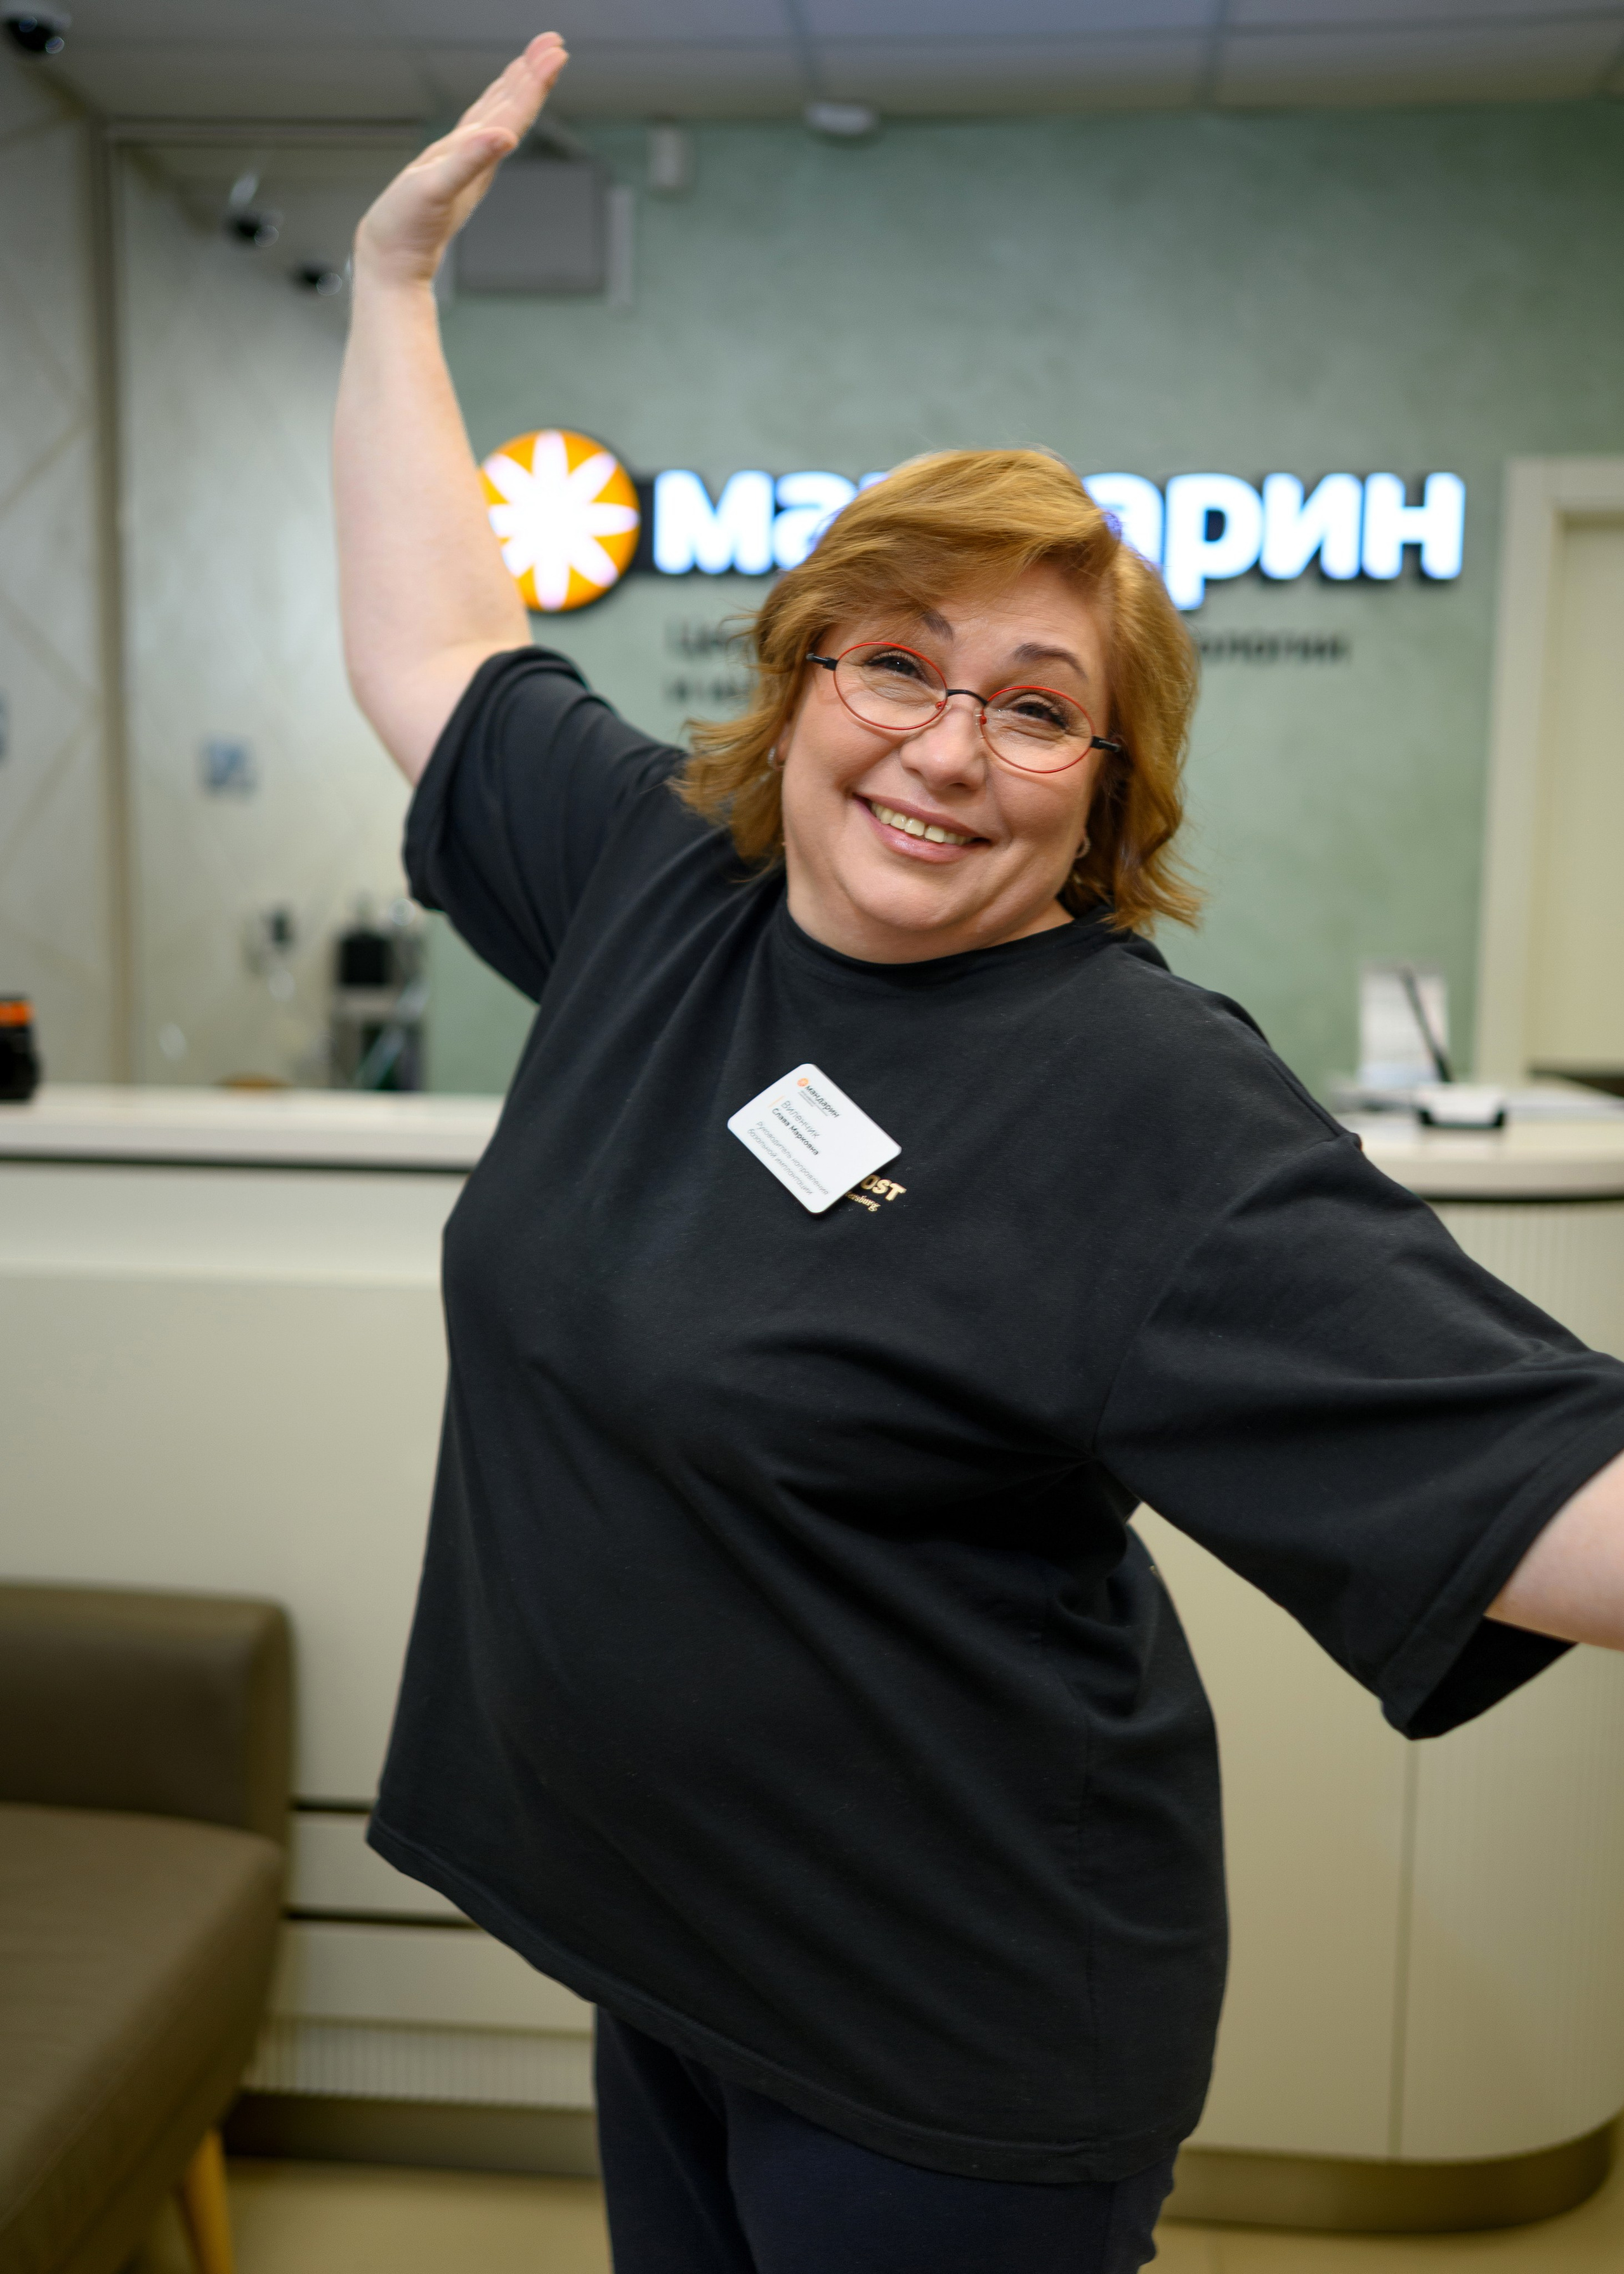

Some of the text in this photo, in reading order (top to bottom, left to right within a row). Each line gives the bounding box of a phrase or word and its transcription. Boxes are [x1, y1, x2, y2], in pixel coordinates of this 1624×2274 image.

[652, 468, 1466, 611] маарин
[781, 1100, 821, 1140] Виленчик
[804, 1085, 841, 1118] мандарин
[771, 1108, 820, 1156] Слава Марковна
[747, 1127, 778, 1159] базальной
[775, 1157, 813, 1195] имплантации
[756, 1120, 829, 1195] Руководитель направления
[860, 1174, 907, 1202] OST
